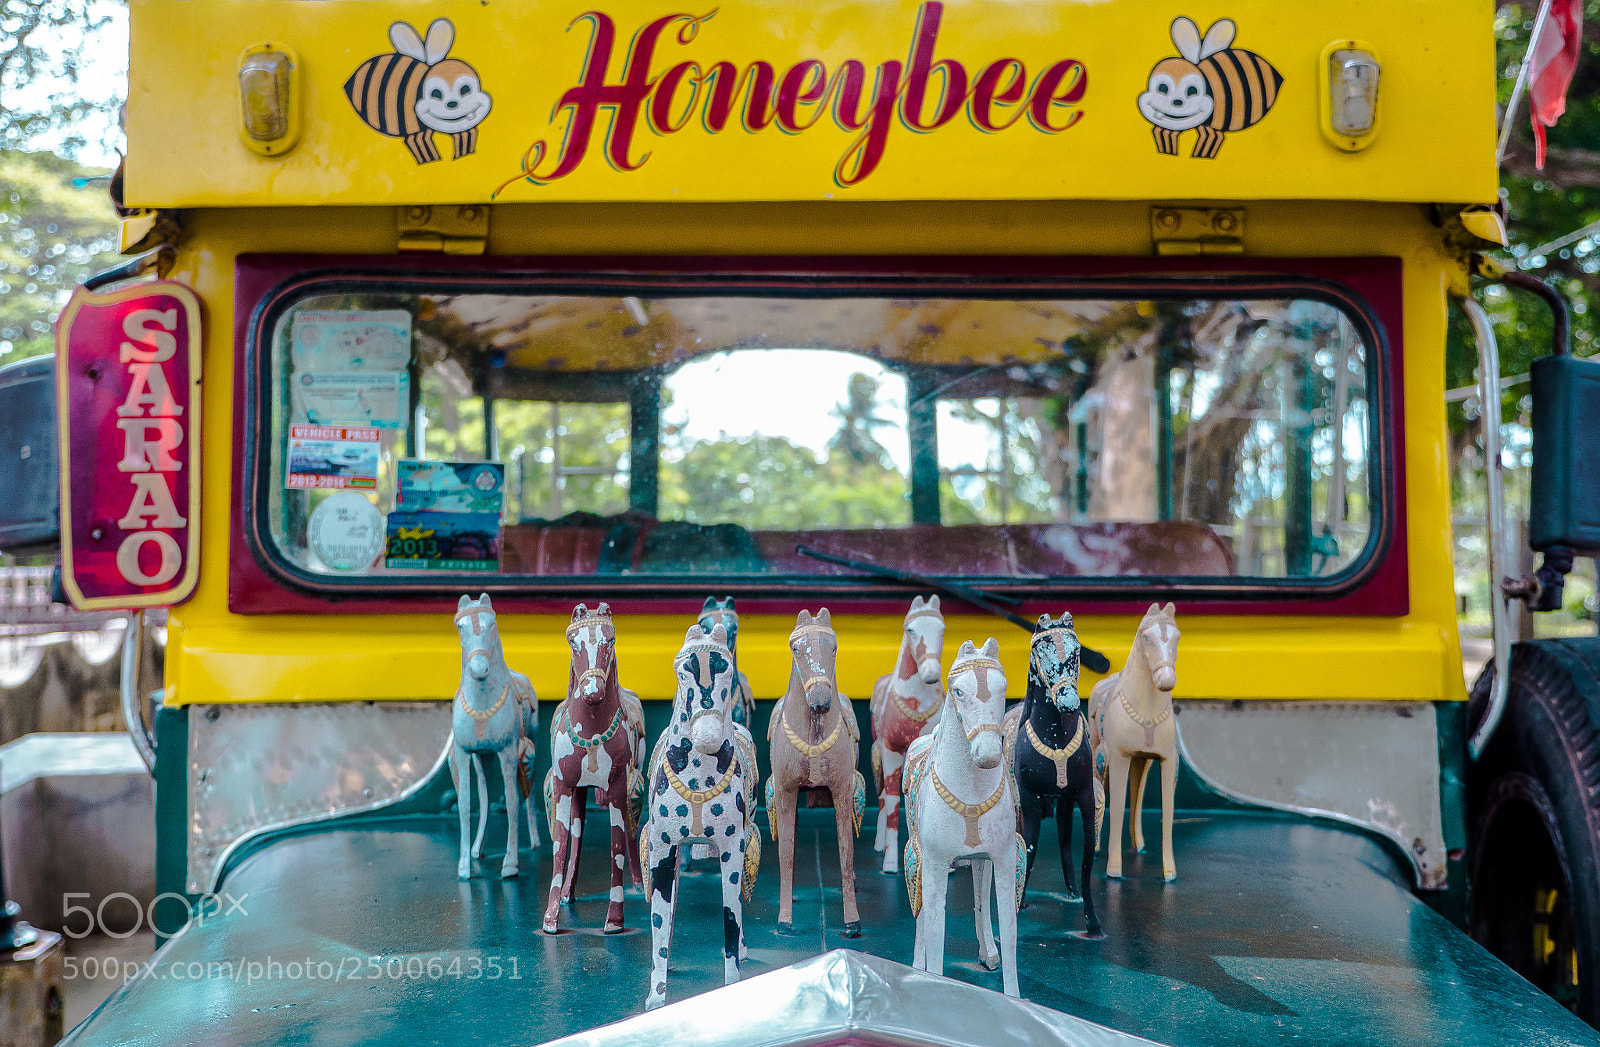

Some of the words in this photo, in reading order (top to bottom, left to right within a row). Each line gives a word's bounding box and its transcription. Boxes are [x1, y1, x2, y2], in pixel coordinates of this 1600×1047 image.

[492, 1, 1089, 200] Honeybee
[116, 308, 188, 587] SARAO
[295, 427, 342, 439] VEHICLE
[347, 429, 378, 440] PASS
[390, 538, 438, 555] 2013
